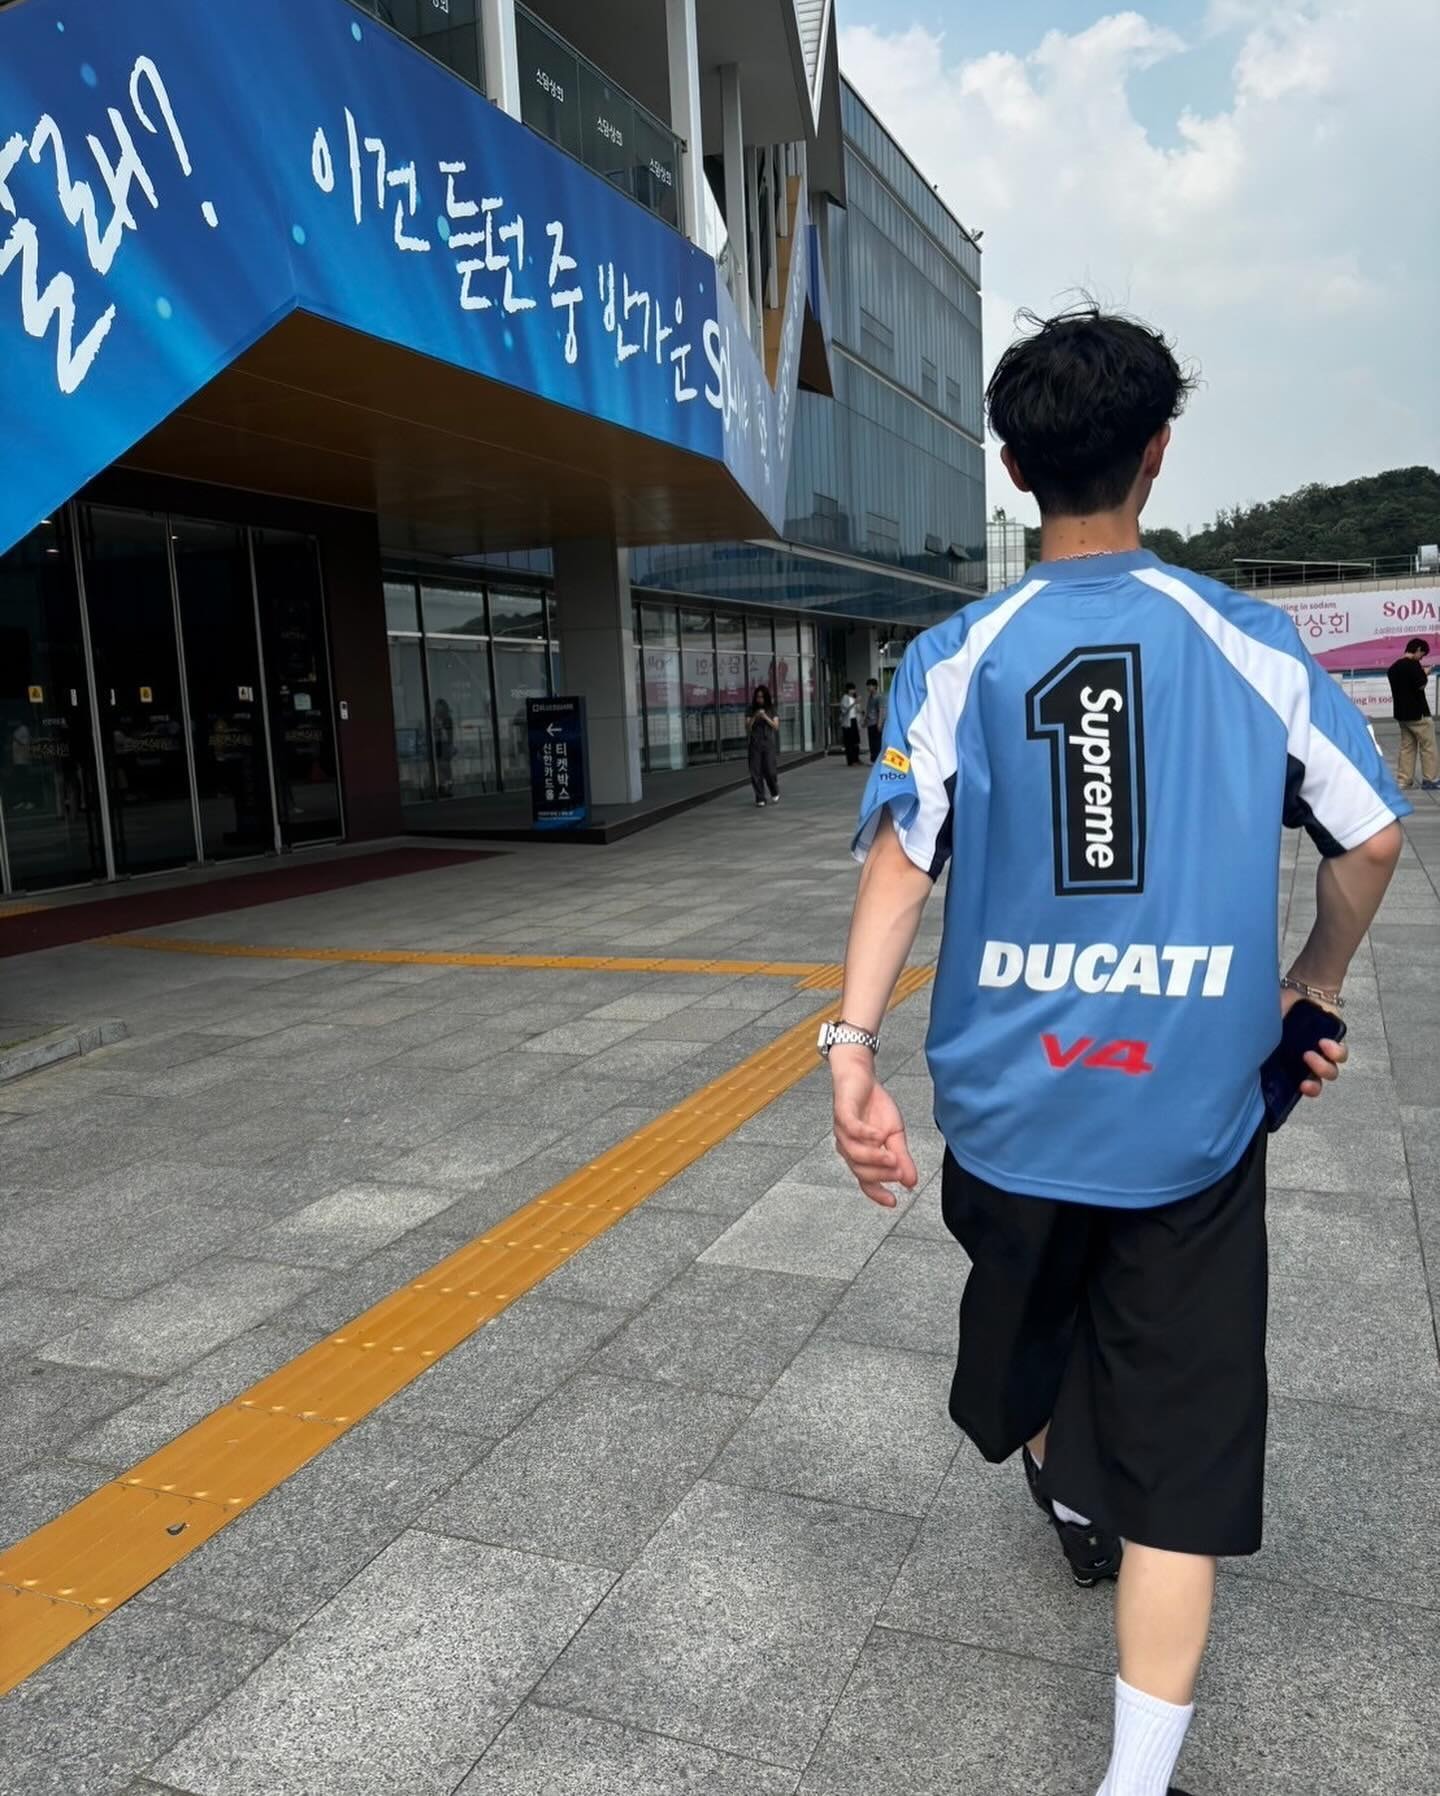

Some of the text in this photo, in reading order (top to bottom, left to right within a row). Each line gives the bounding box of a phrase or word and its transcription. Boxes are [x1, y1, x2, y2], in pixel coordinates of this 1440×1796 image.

[536, 68, 564, 102] 소담상회
[597, 116, 623, 147] 소담상회
[649, 158, 672, 186] 소담상회
[311, 106, 431, 251] 이건
[439, 161, 537, 313] 듣던
[545, 221, 584, 364] 중
[599, 262, 697, 402] 반가운
[1310, 600, 1337, 610] sodam
[1383, 599, 1440, 622] SODA
[555, 742, 570, 800] 티켓박스
[1025, 643, 1146, 896] 1
[1069, 685, 1123, 869] Supreme
[978, 941, 1234, 997] DUCATI
[1039, 1033, 1156, 1075] V4
